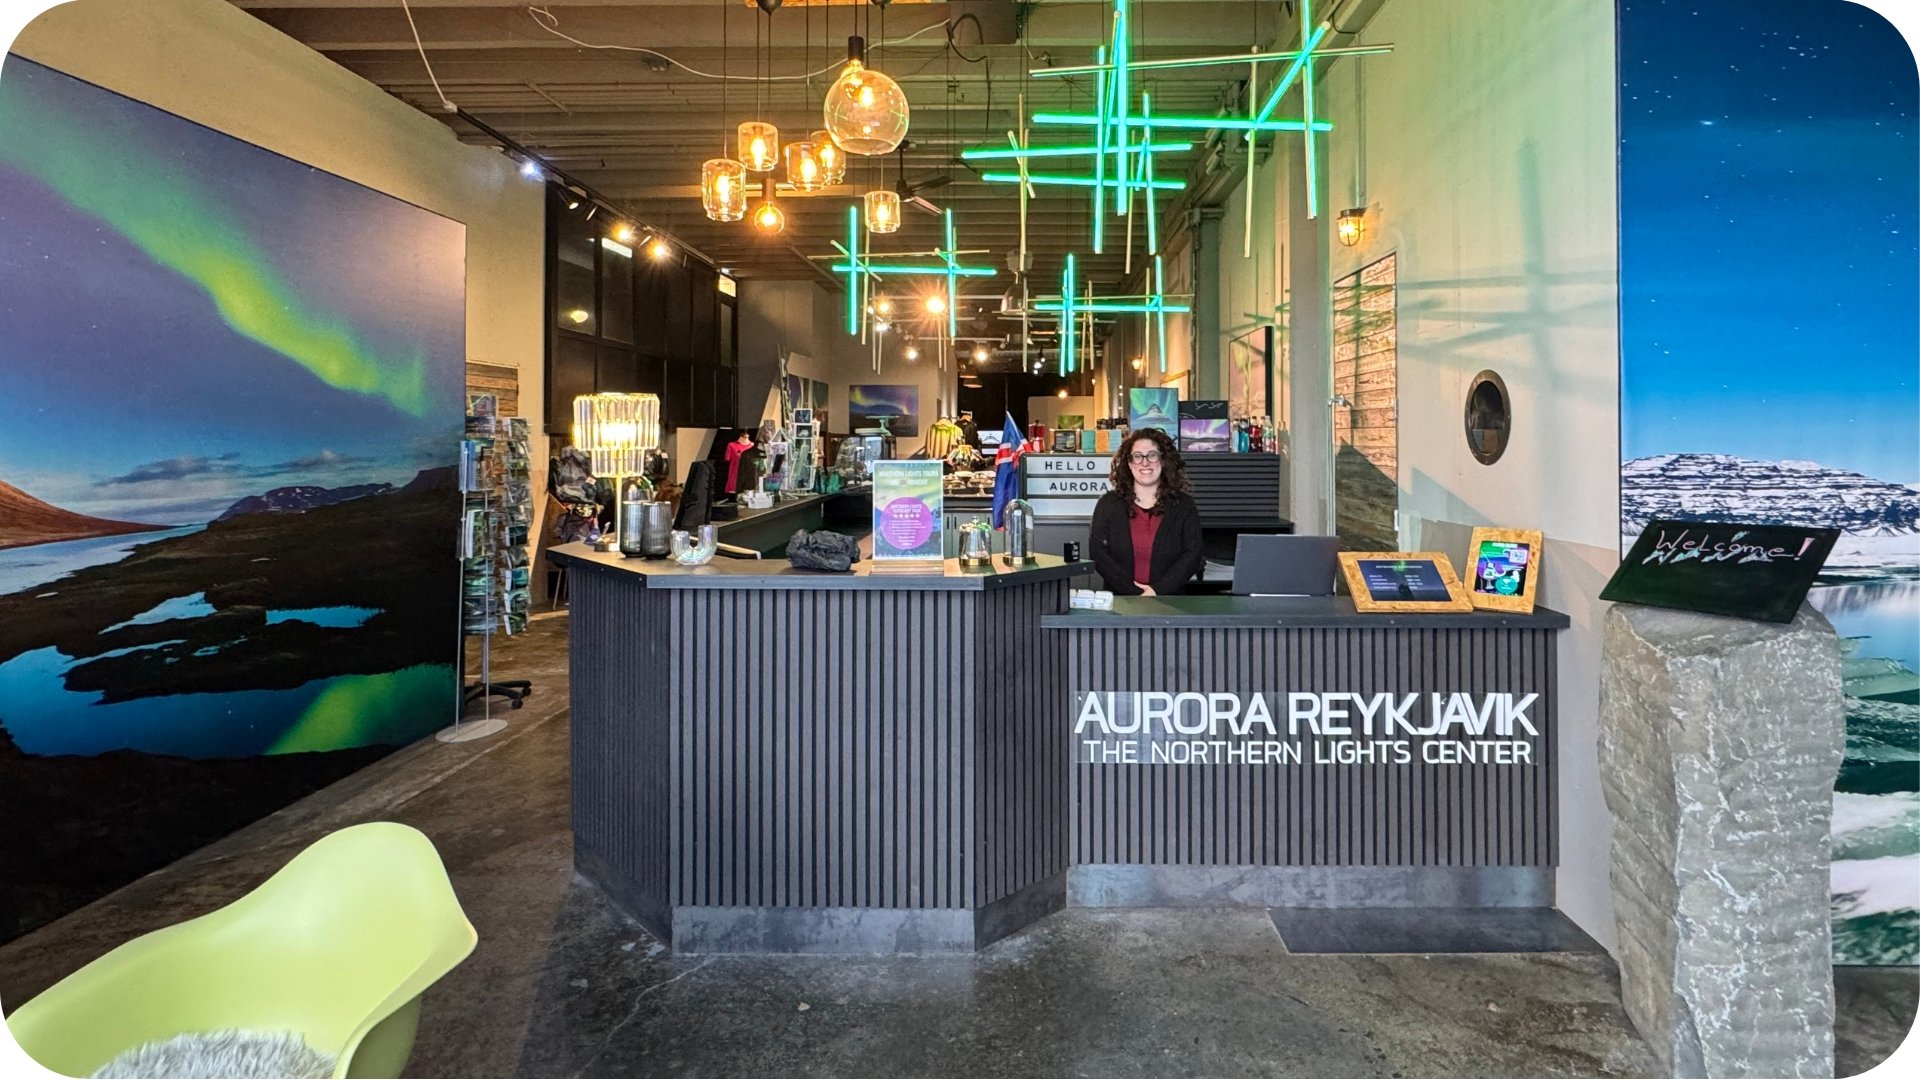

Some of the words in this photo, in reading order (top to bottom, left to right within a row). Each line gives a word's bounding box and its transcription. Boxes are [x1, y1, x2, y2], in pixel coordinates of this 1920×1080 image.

[1045, 461, 1096, 471] HELLO
[1049, 482, 1108, 492] AURORA
[1074, 691, 1277, 735] AURORA
[1288, 692, 1539, 735] REYKJAVIK
[1083, 740, 1137, 763] THE
[1151, 740, 1301, 764] NORTHERN
[1314, 740, 1411, 764] LIGHTS
[1422, 740, 1531, 764] CENTER
